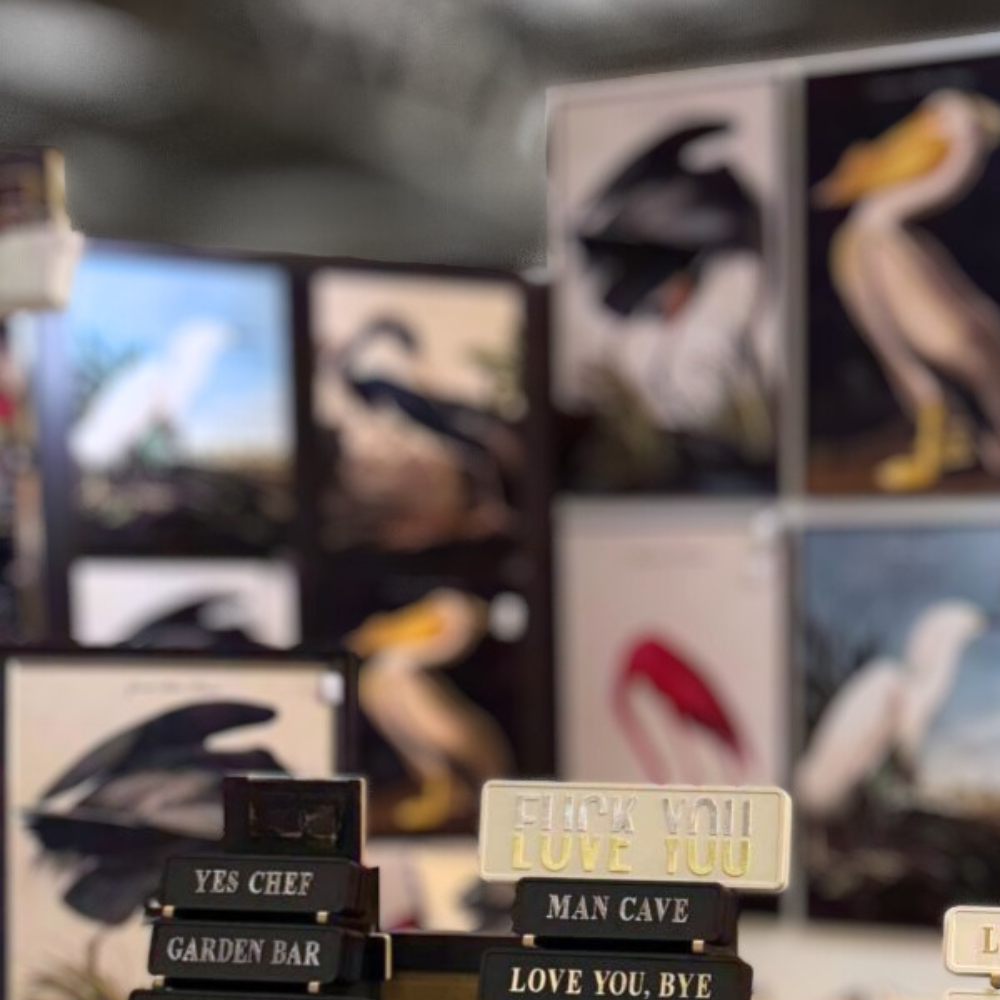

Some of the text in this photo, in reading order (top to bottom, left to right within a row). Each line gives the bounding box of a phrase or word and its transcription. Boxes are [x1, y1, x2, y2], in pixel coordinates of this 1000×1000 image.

[195, 869, 314, 897] YES CHEF
[547, 893, 689, 923] MAN CAVE
[166, 936, 320, 966] GARDEN BAR
[509, 967, 712, 999] LOVE YOU, BYE
